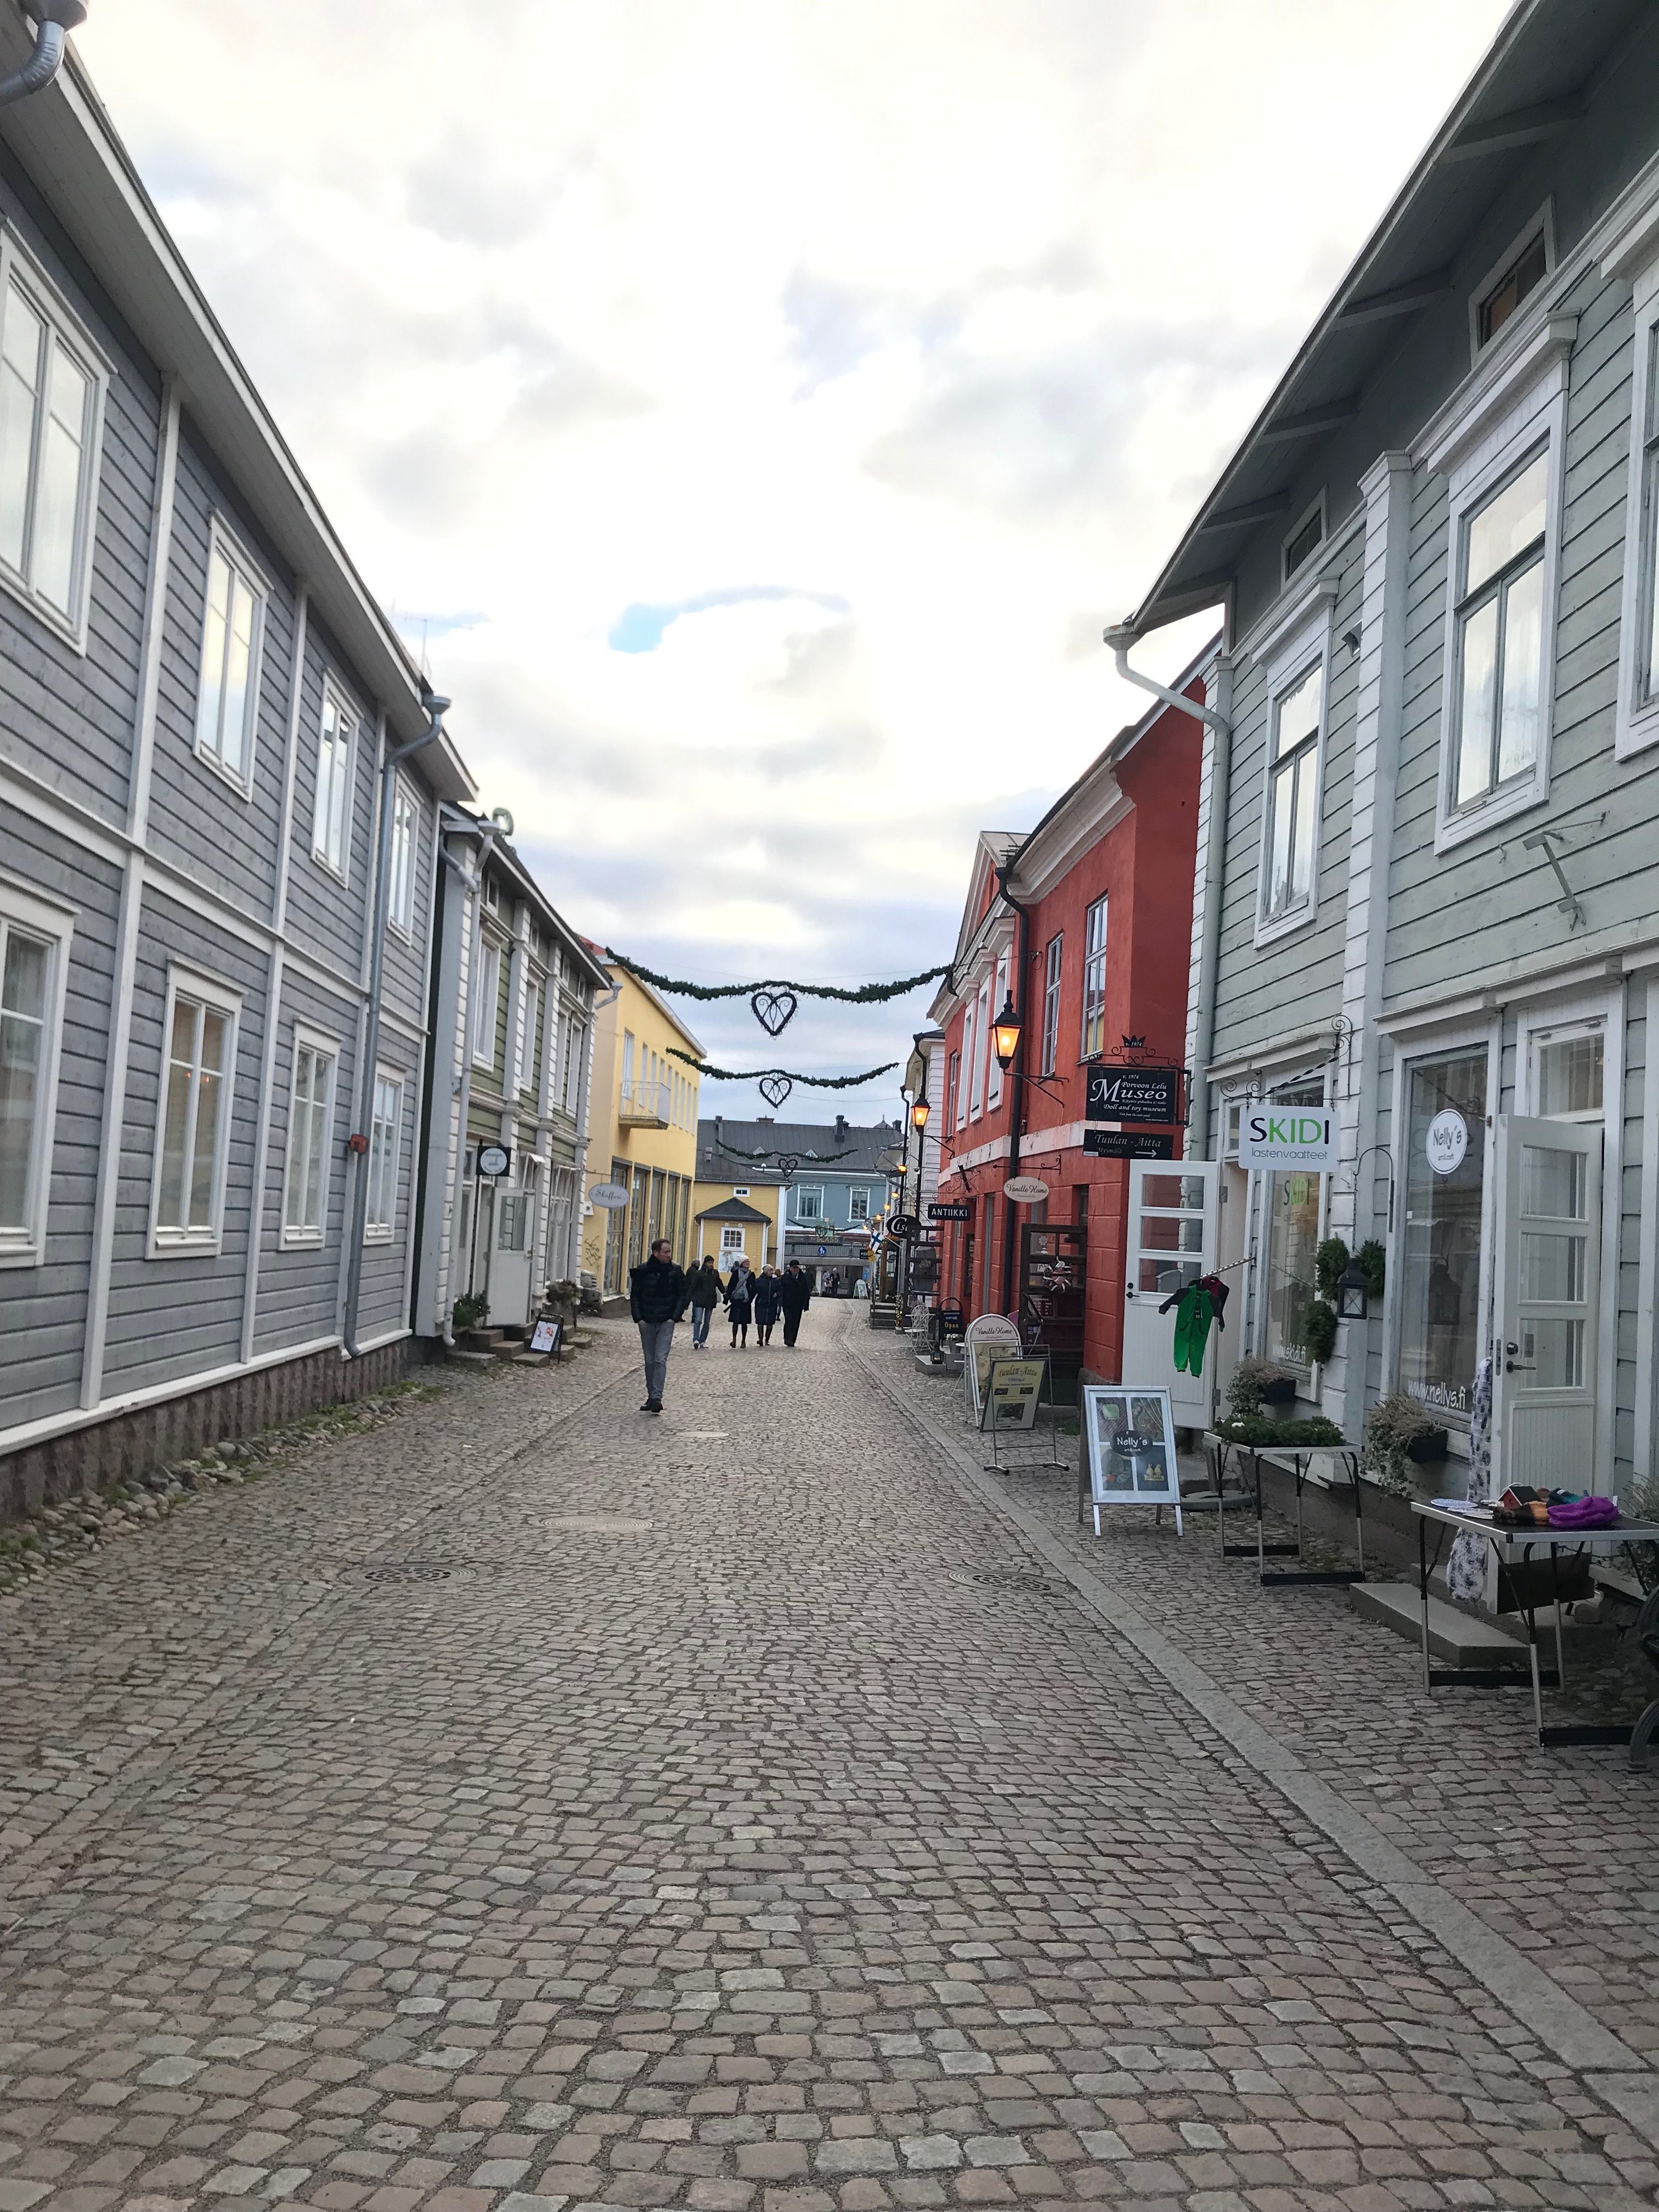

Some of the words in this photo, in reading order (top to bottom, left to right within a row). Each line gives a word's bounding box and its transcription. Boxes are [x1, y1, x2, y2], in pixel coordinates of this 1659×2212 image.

[1090, 1079, 1167, 1102] Museo
[1249, 1117, 1330, 1145] SKIDI
[1094, 1134, 1127, 1145] Tuulan
[1135, 1137, 1161, 1147] Aitta
[1251, 1147, 1328, 1160] lastenvaatteet
[1006, 1183, 1029, 1193] Vanille
[1029, 1185, 1047, 1194] Home
[1283, 1178, 1310, 1206] SKIDI
[931, 1208, 968, 1217] ANTIIKKI
[996, 1327, 1013, 1335] Home
[1408, 1379, 1466, 1412] www.nellys.fi
